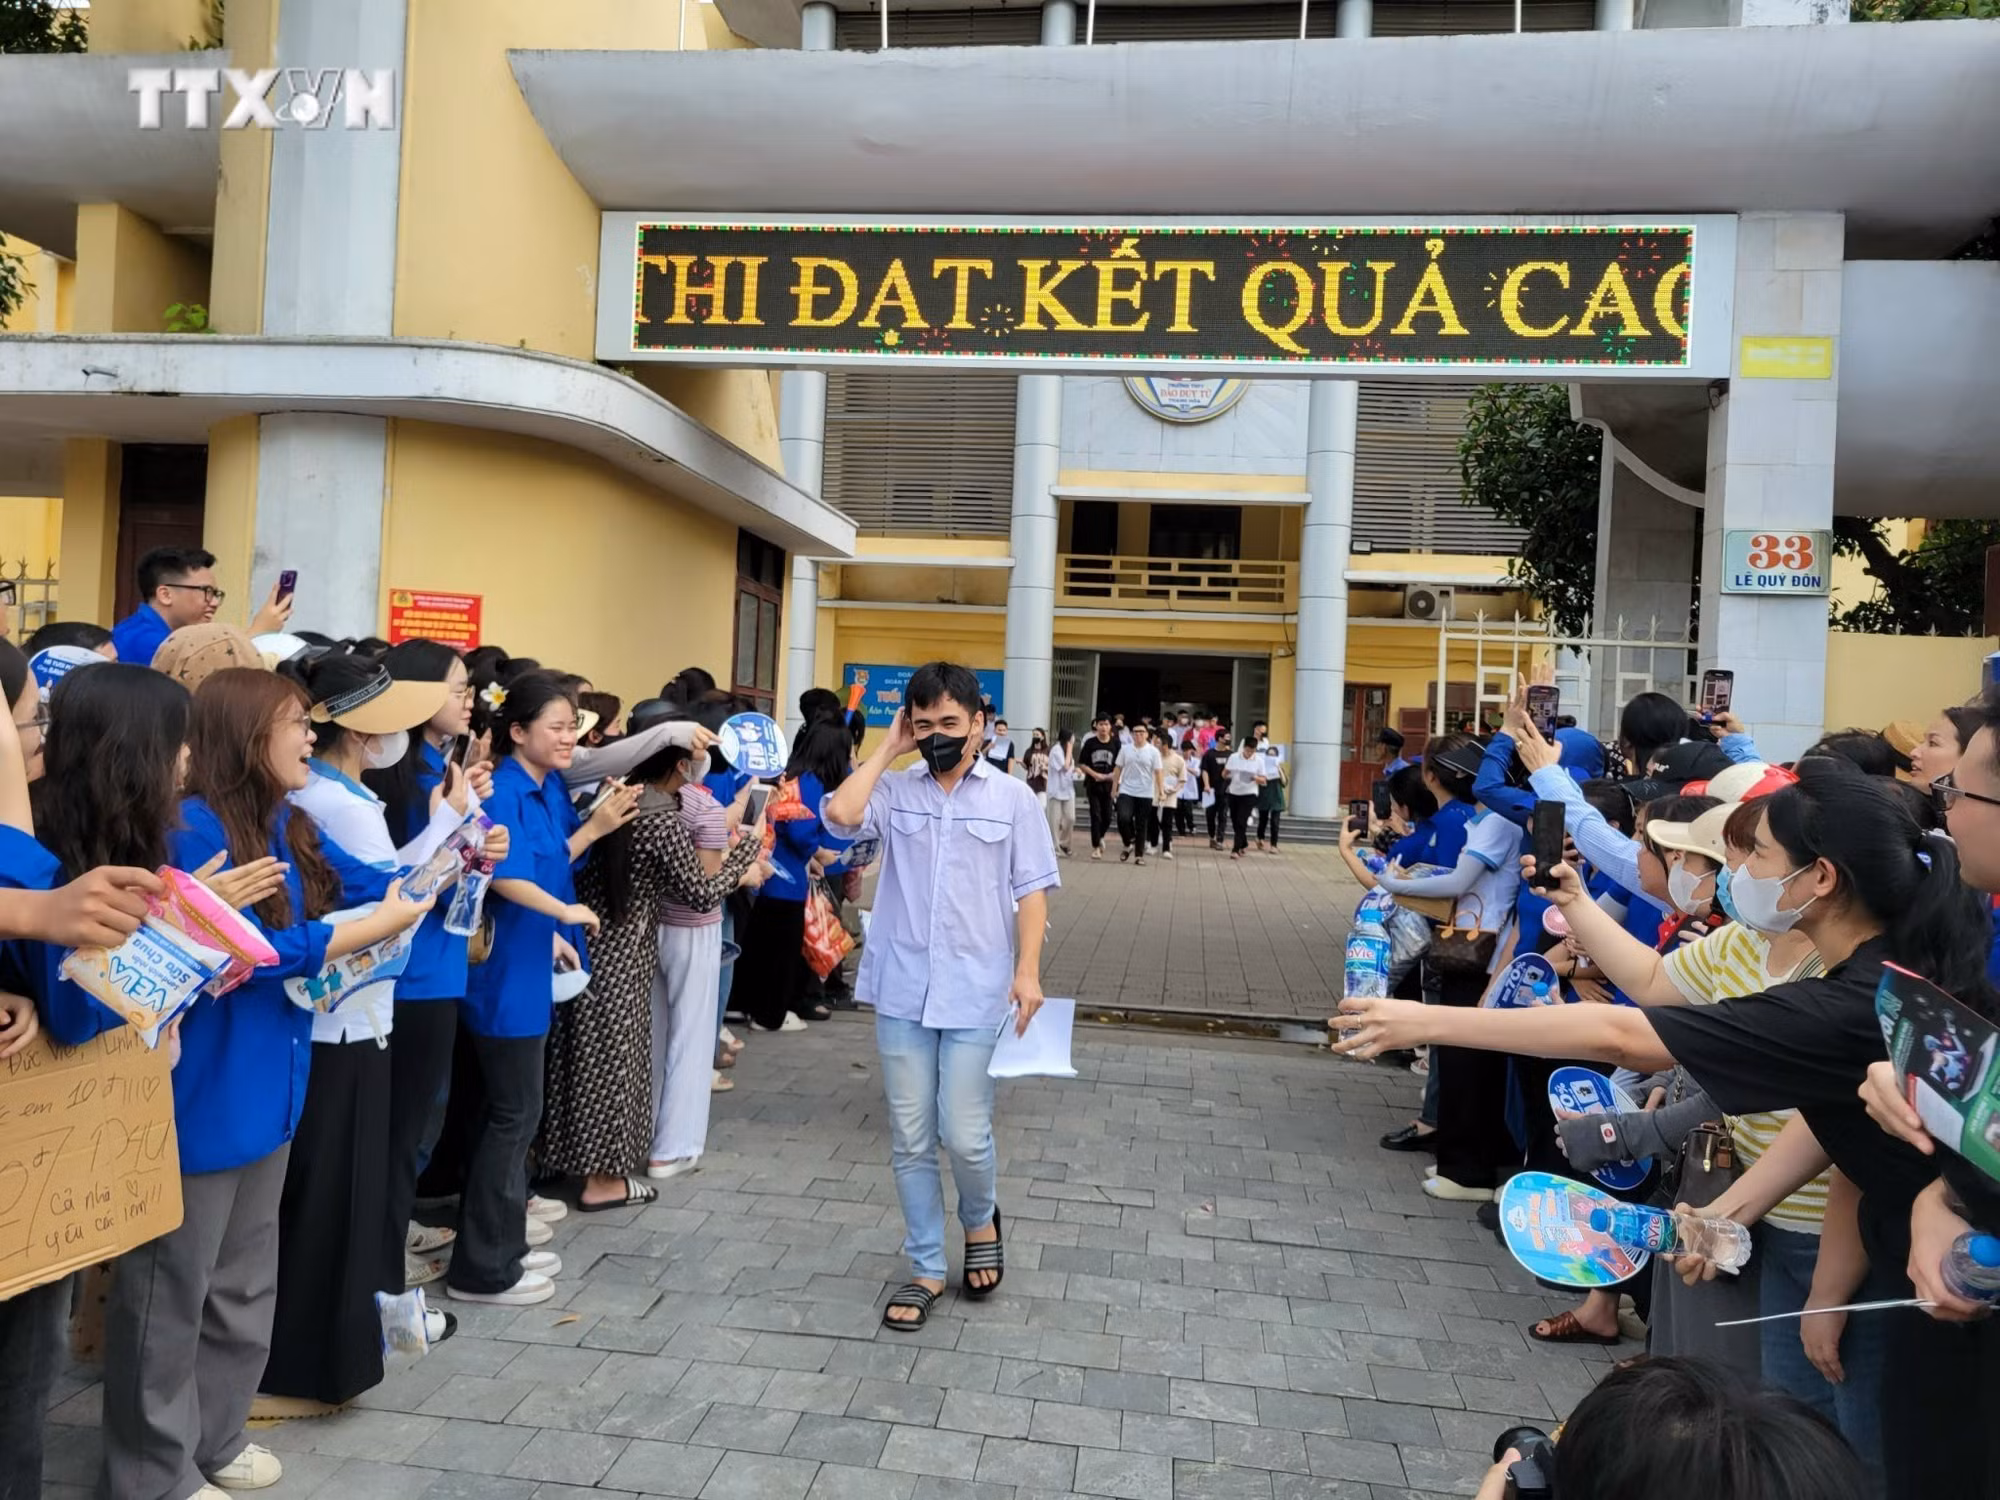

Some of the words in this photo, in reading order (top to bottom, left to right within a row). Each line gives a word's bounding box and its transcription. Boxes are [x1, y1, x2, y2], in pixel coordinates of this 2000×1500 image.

[1015, 238, 1215, 332] KẾT
[1242, 238, 1469, 353] QUẢ
[1747, 533, 1814, 571] 33
[1735, 571, 1752, 586] LÊ
[1758, 572, 1786, 588] QUÝ
[1791, 573, 1821, 588] ĐÔN
[132, 938, 163, 964] Chua
[1348, 946, 1374, 958] aVie
[108, 955, 167, 1013] VELA
[19, 1101, 53, 1117] em
[50, 1187, 75, 1216] Cả
[45, 1222, 85, 1258] yêu
[1648, 1216, 1661, 1248] aVie
